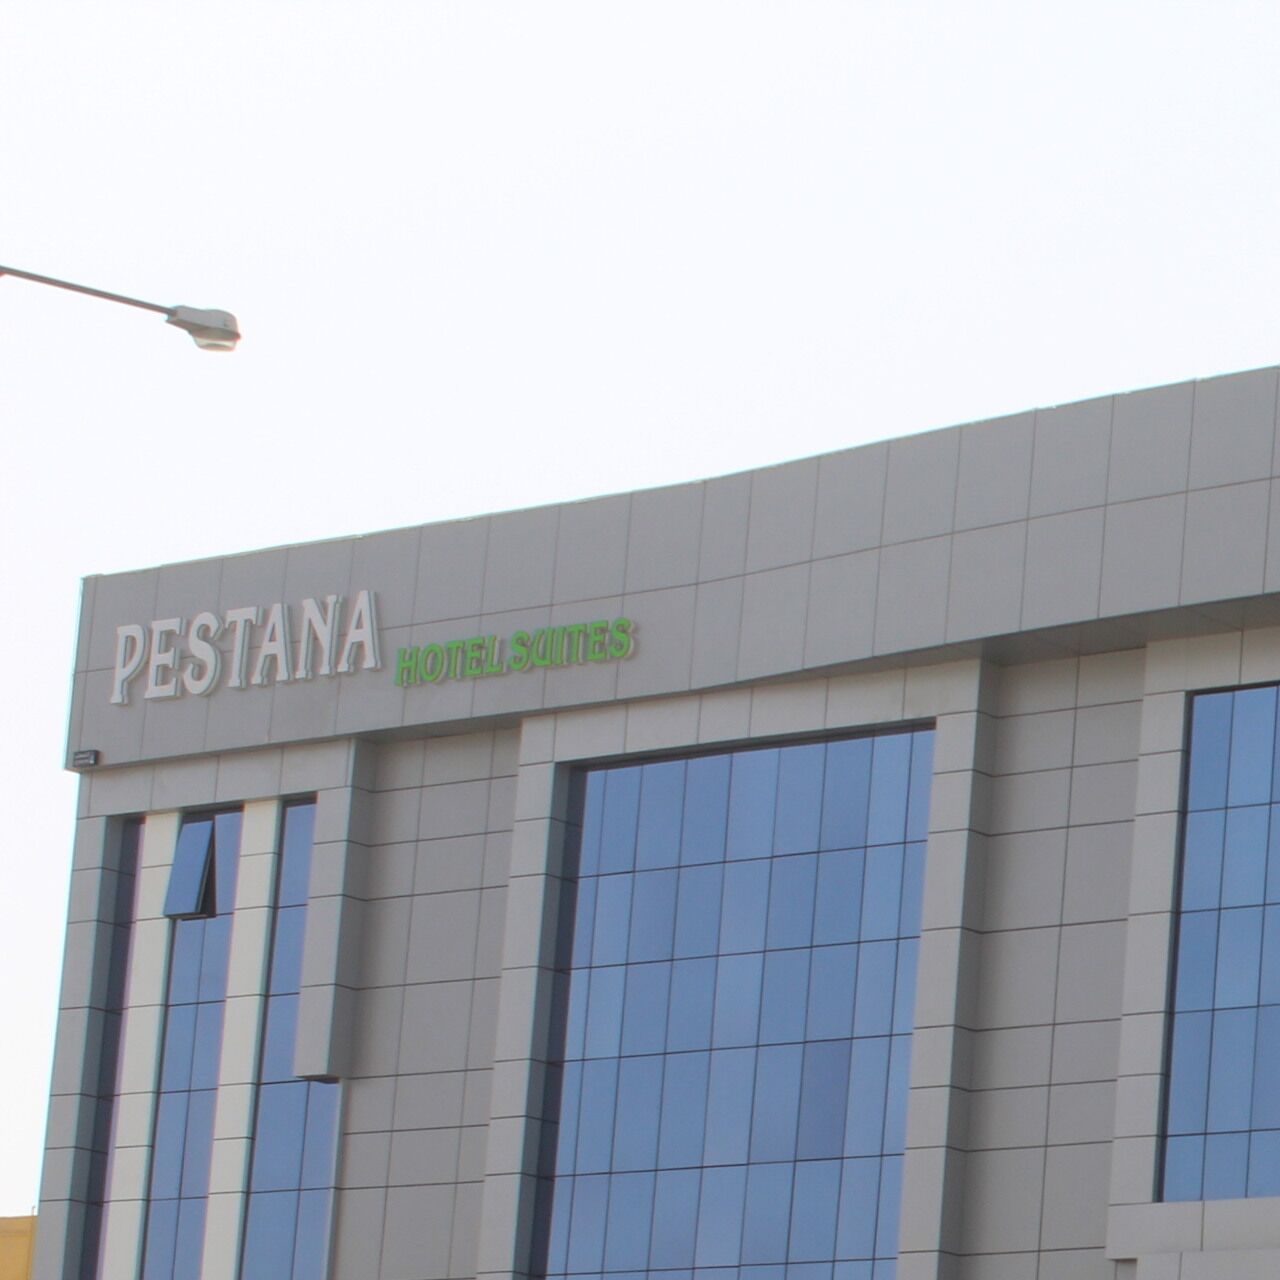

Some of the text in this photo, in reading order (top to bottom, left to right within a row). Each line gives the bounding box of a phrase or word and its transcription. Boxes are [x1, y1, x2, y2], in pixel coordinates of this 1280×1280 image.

[110, 589, 381, 705] PESTANA
[394, 616, 636, 688] HOTEL SUITES
